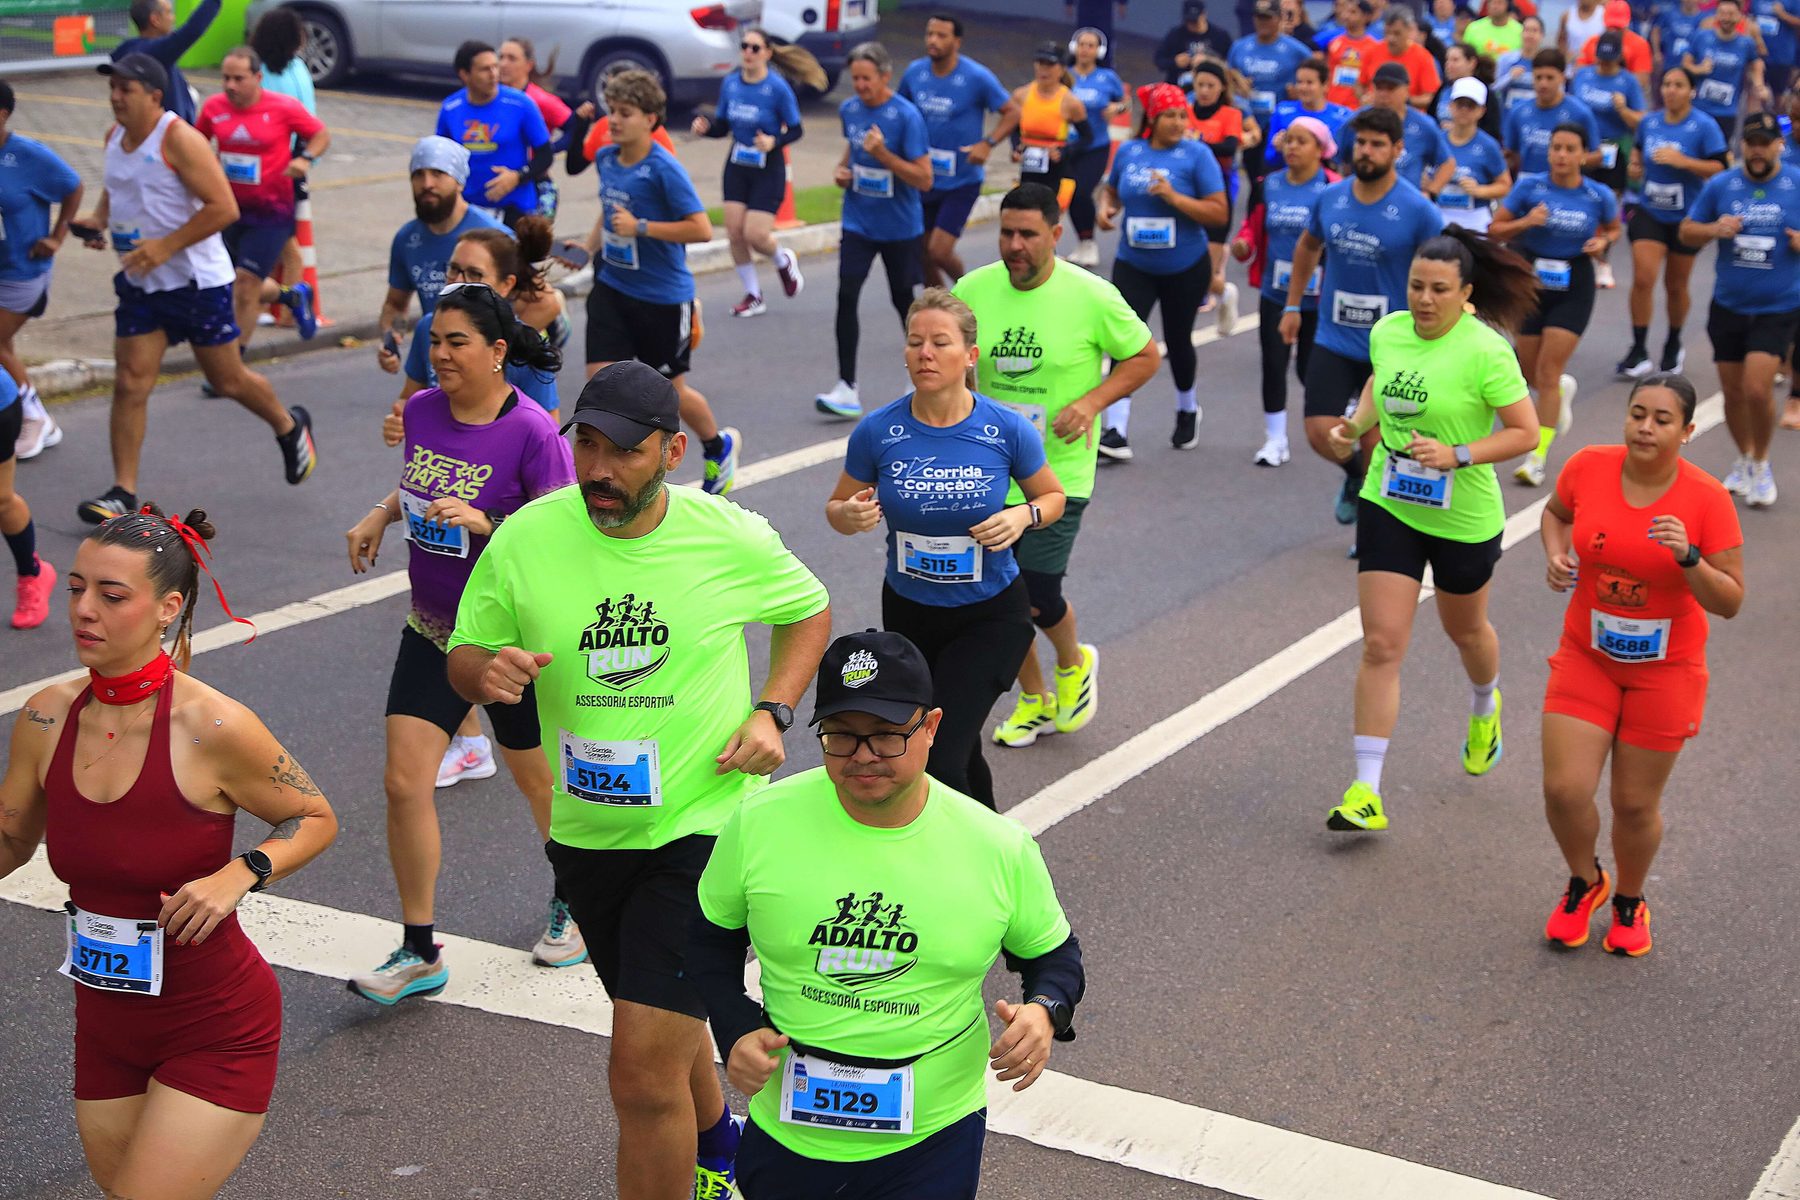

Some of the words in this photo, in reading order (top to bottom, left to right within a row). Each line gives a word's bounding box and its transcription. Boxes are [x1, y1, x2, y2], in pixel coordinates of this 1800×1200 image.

[990, 346, 1043, 359] ADALTO
[1381, 385, 1428, 402] ADALTO
[904, 479, 975, 493] Coração
[1398, 479, 1433, 497] 5130
[411, 521, 447, 543] 5217
[920, 557, 958, 573] 5115
[578, 625, 669, 651] ADALTO
[1604, 635, 1650, 653] 5688
[589, 646, 652, 675] RUN
[841, 660, 878, 675] ADALTO
[845, 670, 871, 684] RUN
[575, 694, 627, 708] ASSESSORIA
[628, 694, 675, 709] ESPORTIVA
[577, 767, 631, 792] 5124
[807, 924, 919, 953] ADALTO
[80, 945, 130, 975] 5712
[818, 947, 897, 972] RUN
[801, 984, 861, 1010] ASSESSORIA
[863, 999, 920, 1016] ESPORTIVA
[813, 1088, 879, 1114] 5129
